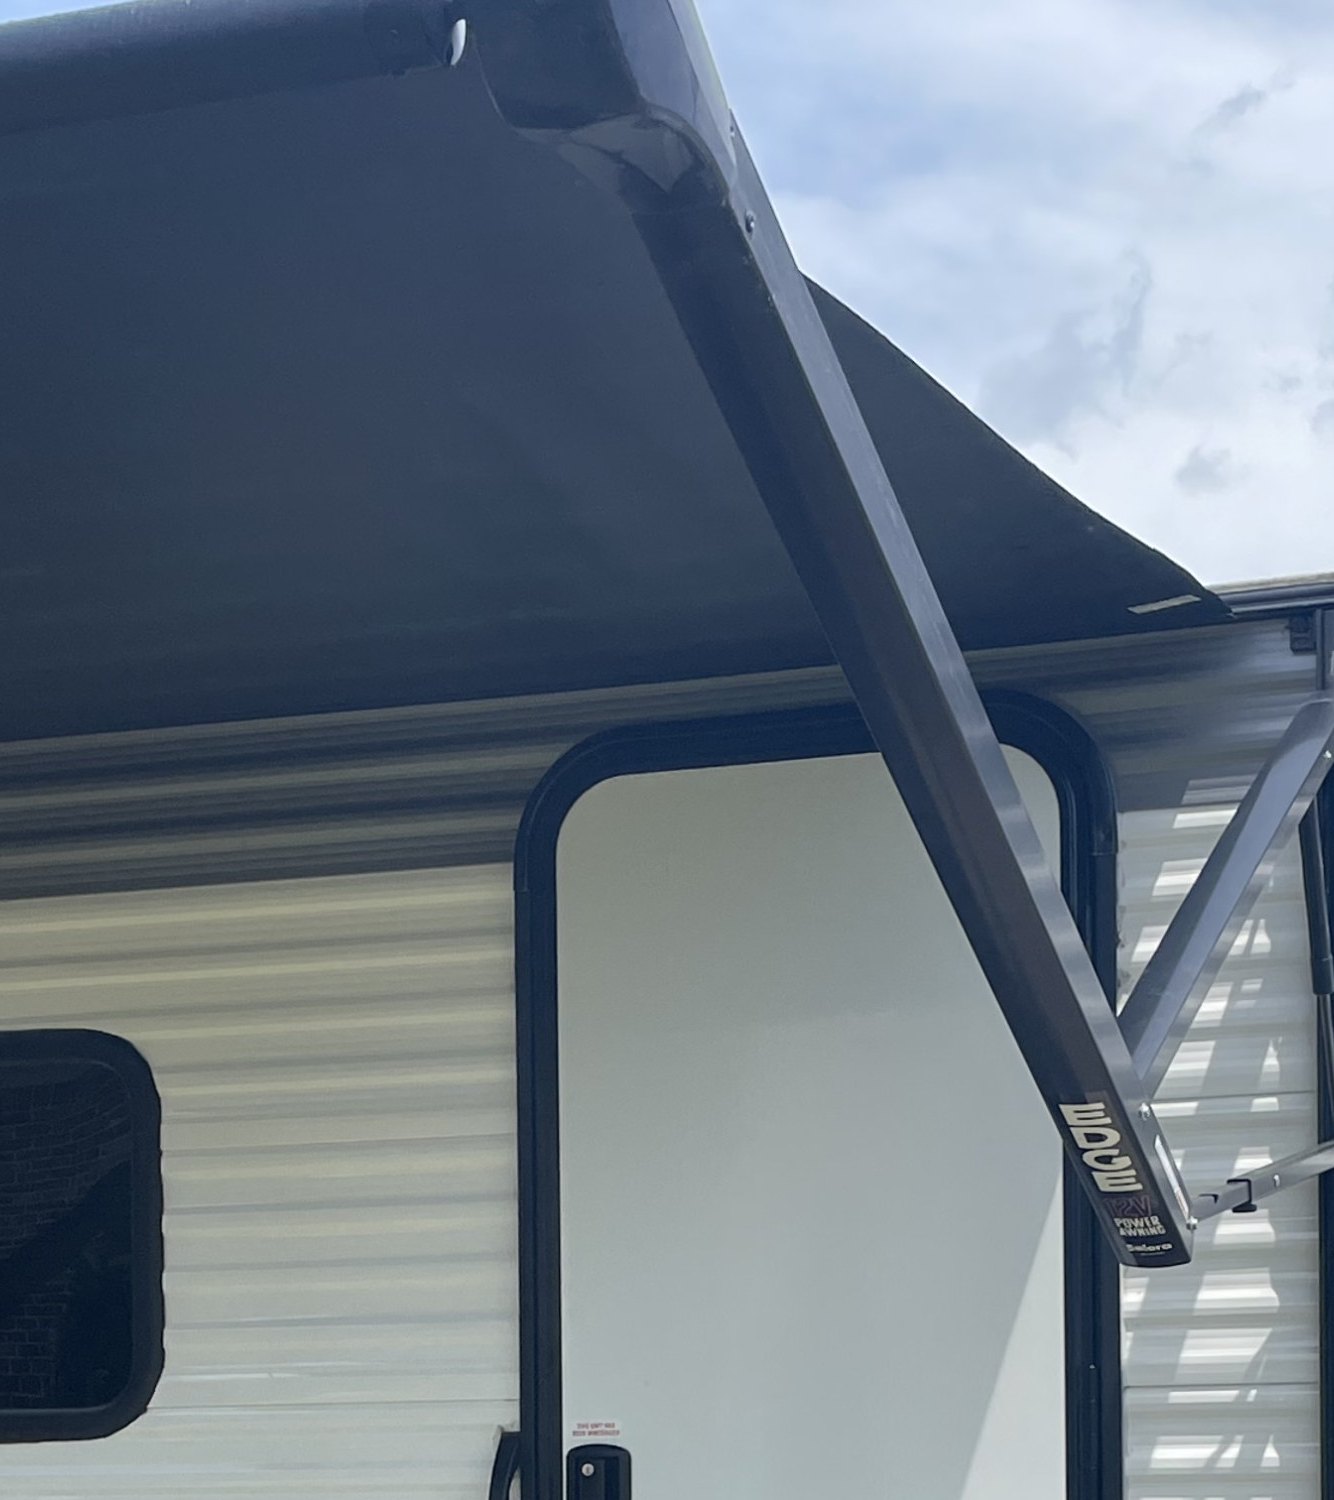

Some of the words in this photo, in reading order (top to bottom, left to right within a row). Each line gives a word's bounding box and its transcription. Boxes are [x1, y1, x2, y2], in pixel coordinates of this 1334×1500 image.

[1058, 1102, 1143, 1192] EDGE
[1113, 1215, 1161, 1228] POWER
[1119, 1225, 1167, 1237] AWNING
